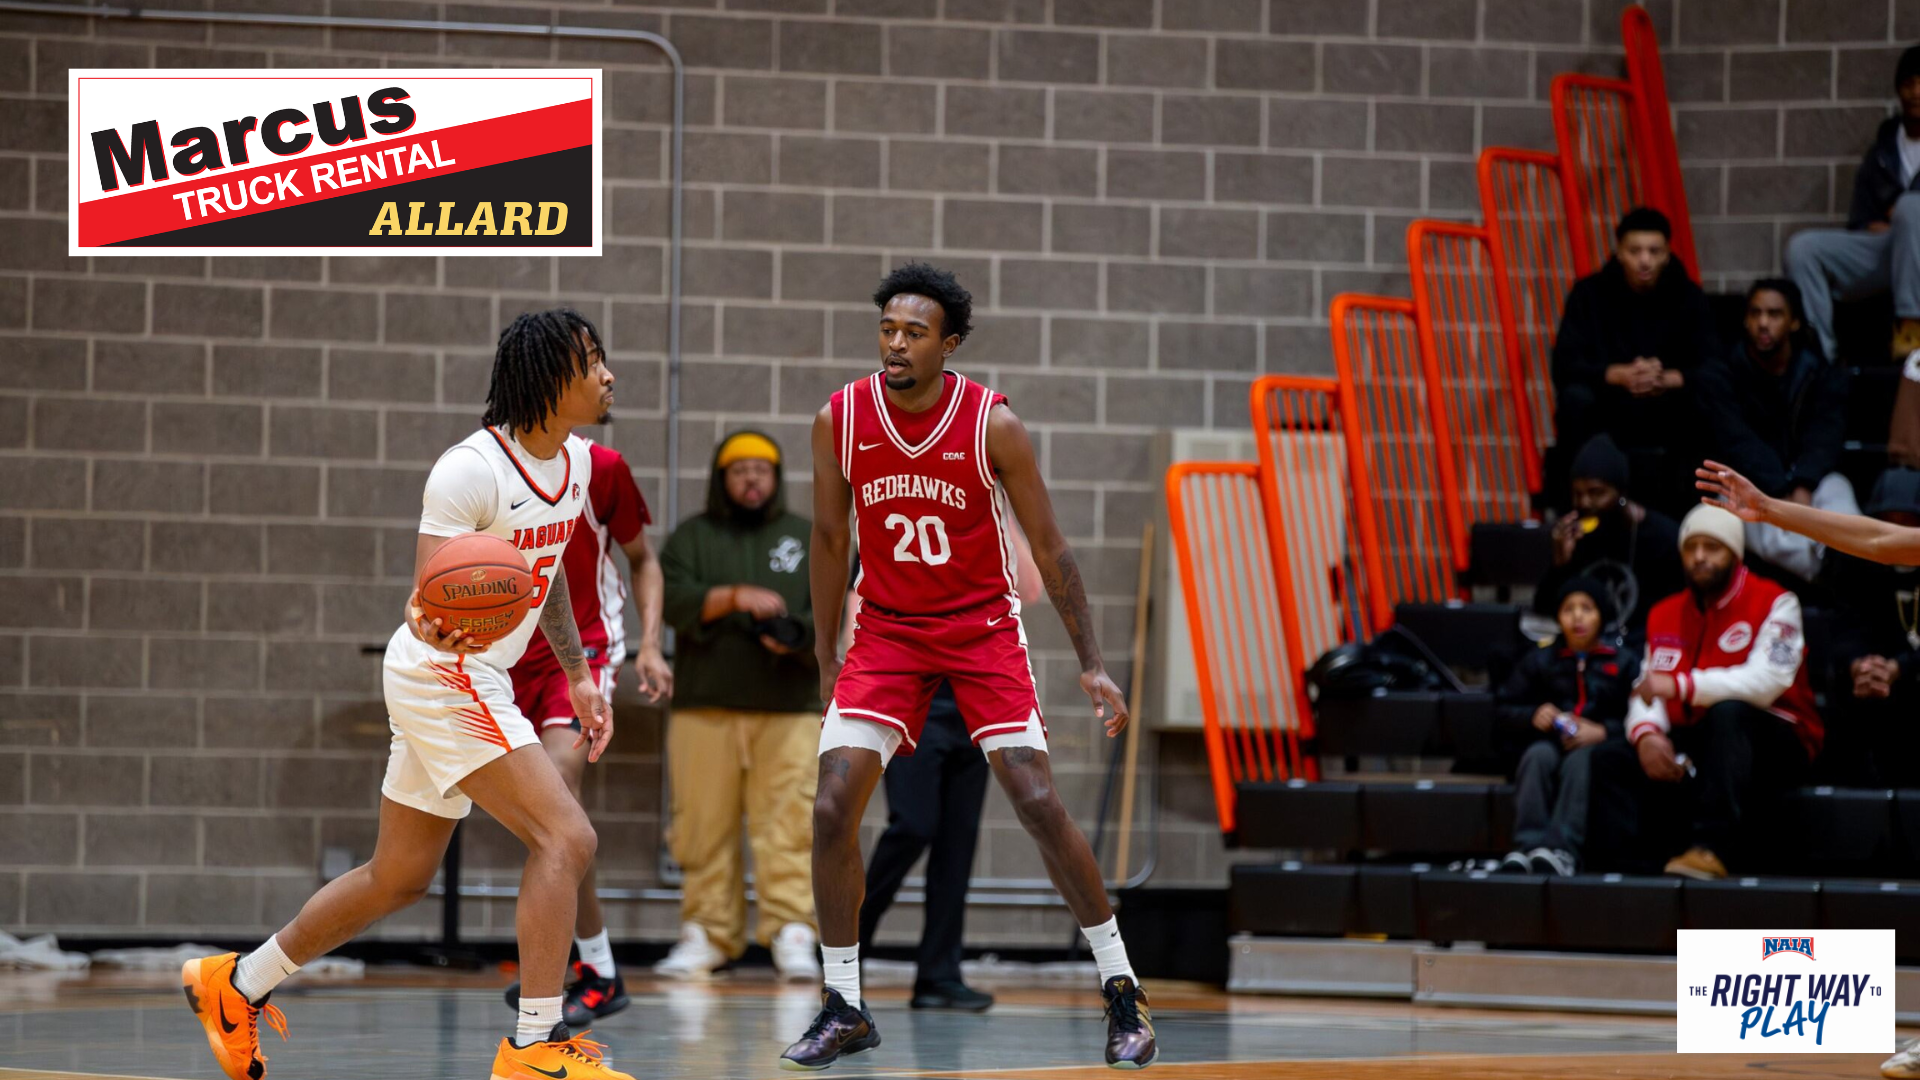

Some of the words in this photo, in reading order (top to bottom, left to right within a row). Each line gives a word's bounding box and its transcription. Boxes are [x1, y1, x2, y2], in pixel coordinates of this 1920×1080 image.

[861, 474, 967, 511] REDHAWKS
[884, 513, 952, 567] 20
[442, 577, 518, 602] SPALDING
[449, 610, 514, 629] LEGACY
